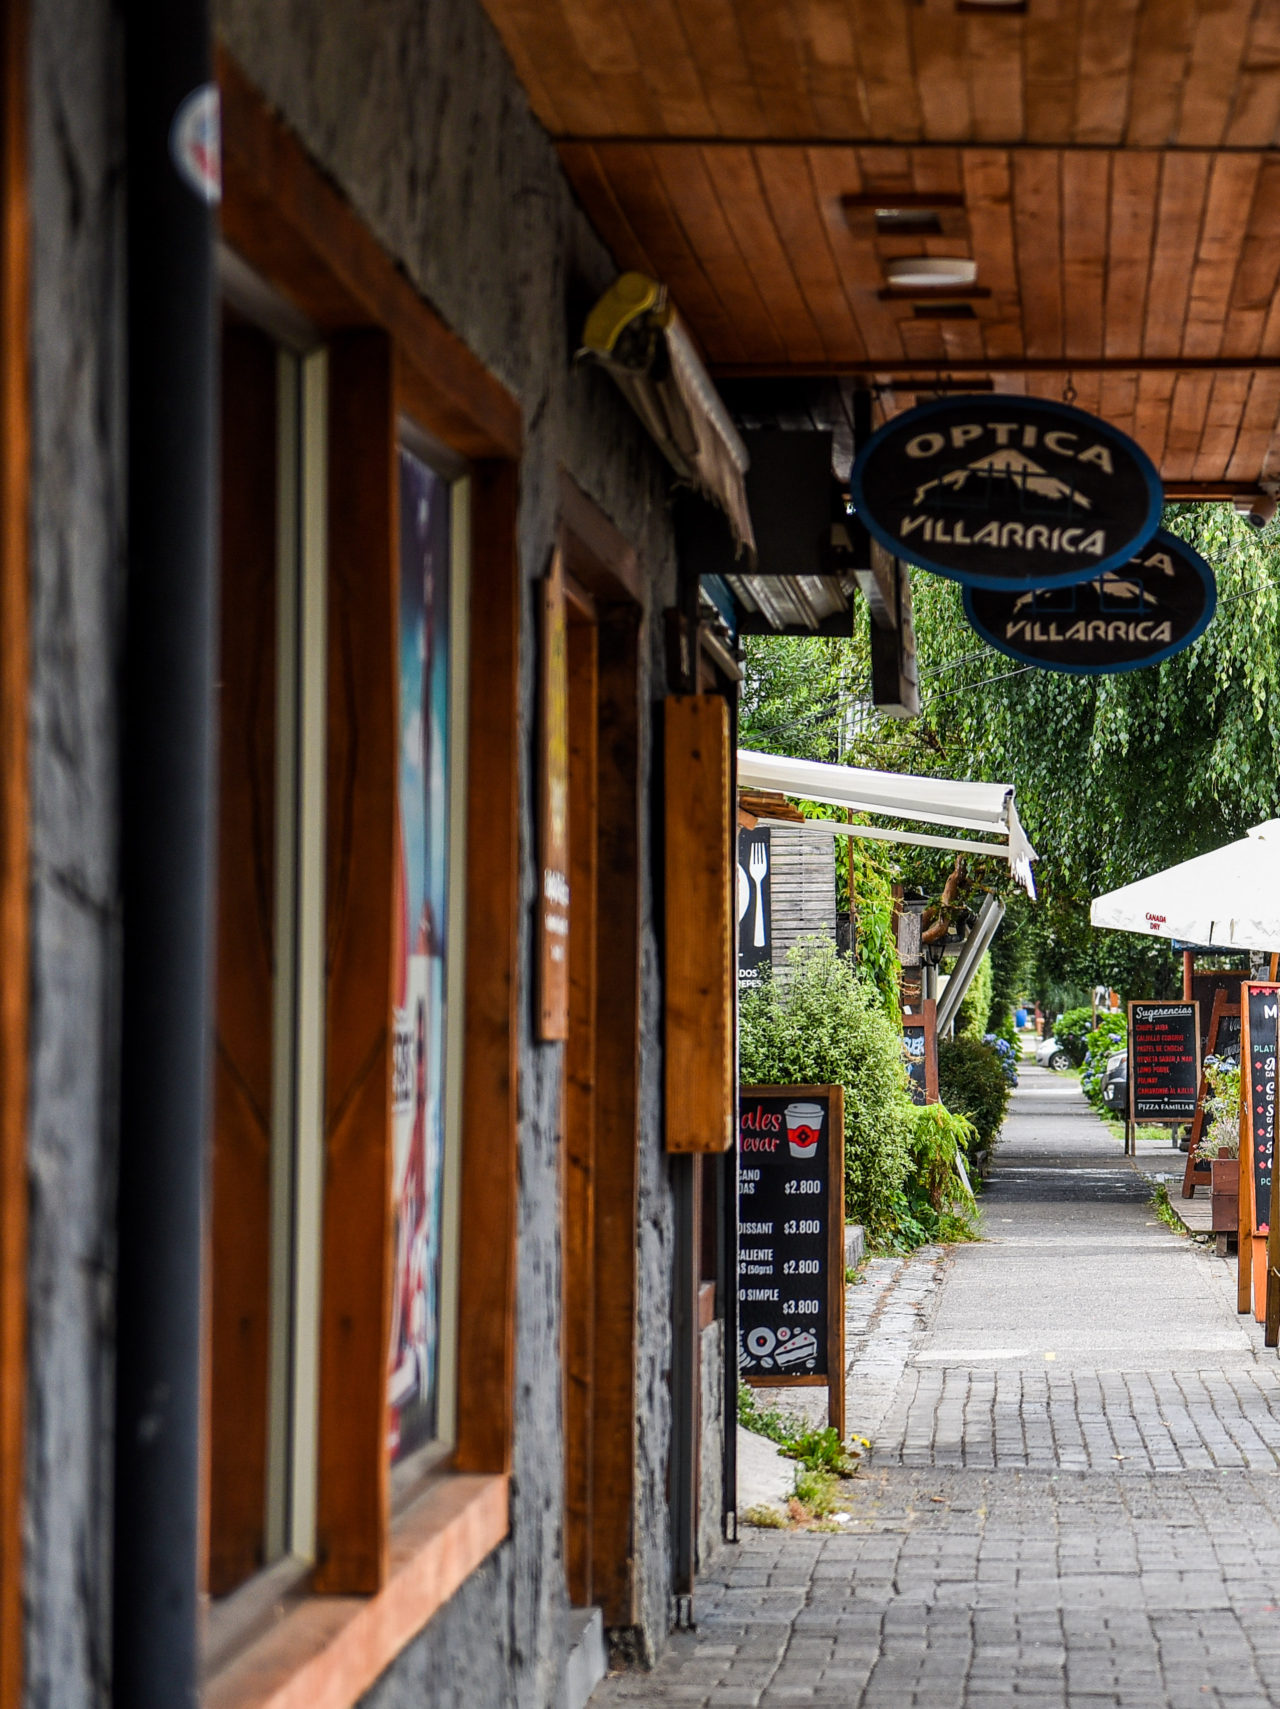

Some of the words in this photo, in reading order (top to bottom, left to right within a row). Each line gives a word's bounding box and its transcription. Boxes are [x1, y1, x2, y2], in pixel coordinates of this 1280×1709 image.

[905, 422, 1115, 475] OPTICA
[901, 515, 1107, 555] VILLARRICA
[1006, 620, 1172, 642] VILLARRICA
[1145, 912, 1167, 923] CANADA
[1150, 922, 1161, 930] DRY
[739, 969, 758, 978] DOS
[1135, 1005, 1192, 1022] Sugerencias
[1254, 1045, 1275, 1053] PLAT
[741, 1105, 782, 1132] ales
[739, 1133, 780, 1153] levar
[784, 1180, 821, 1194] $2.800
[783, 1220, 820, 1234] $3.800
[783, 1259, 819, 1274] $2.800
[747, 1289, 779, 1301] SIMPLE
[783, 1299, 818, 1314] $3.800
